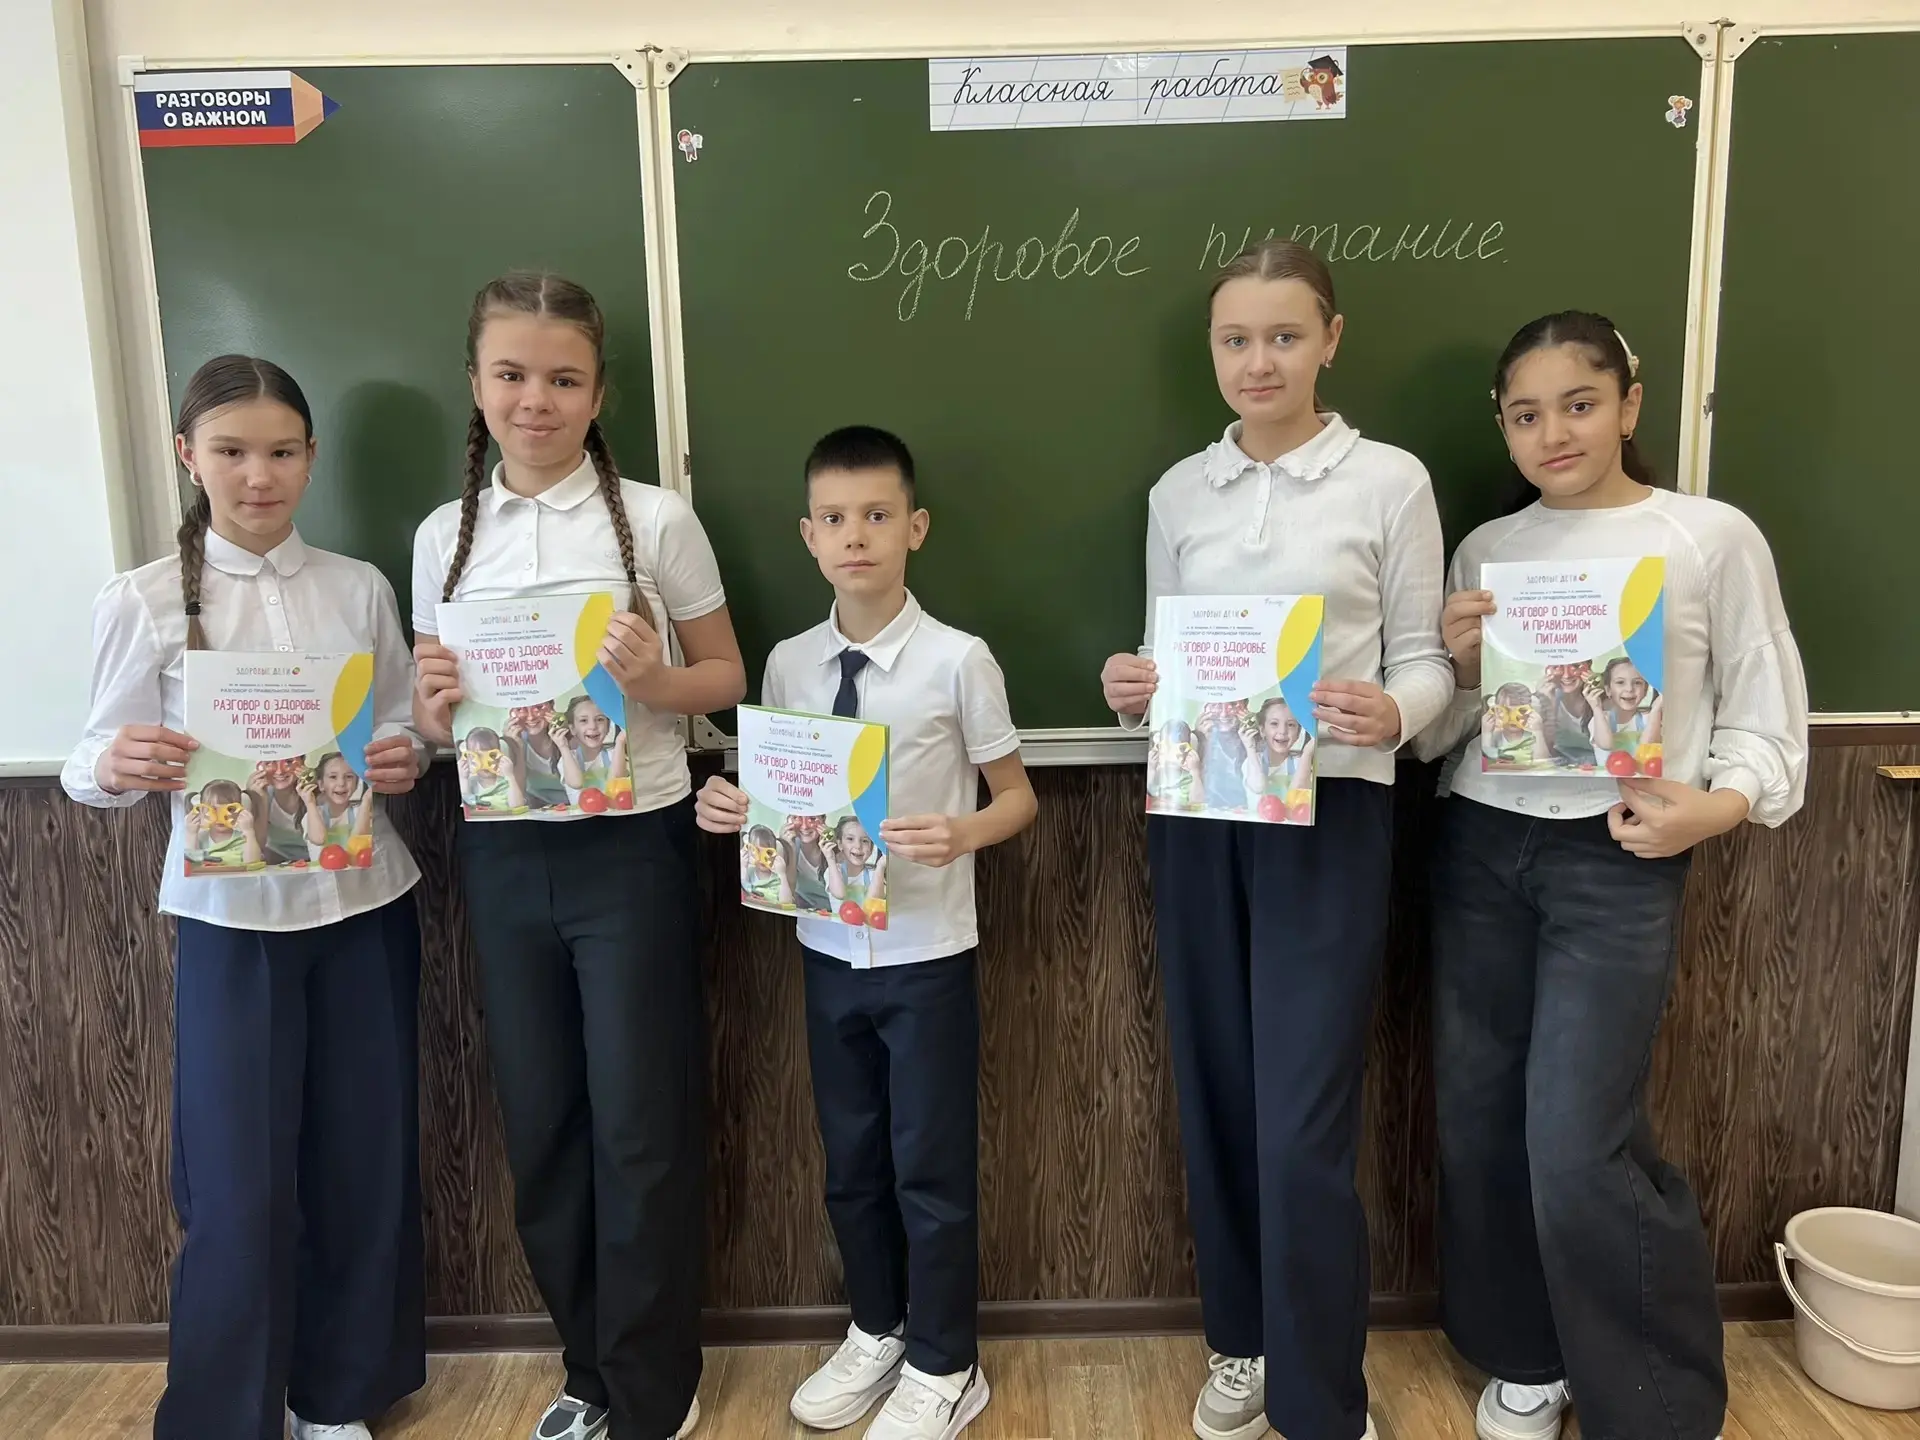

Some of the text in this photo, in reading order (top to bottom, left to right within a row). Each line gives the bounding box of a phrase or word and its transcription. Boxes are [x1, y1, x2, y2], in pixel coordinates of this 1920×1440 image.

[953, 58, 1283, 115] Классная работа
[156, 91, 271, 108] РАЗГОВОРЫ
[163, 110, 267, 127] О ВАЖНОМ
[847, 190, 1151, 322] Здоровое
[1506, 604, 1608, 618] РАЗГОВОР О ЗДОРОВЬЕ
[1522, 619, 1591, 631] И ПРАВИЛЬНОМ
[1535, 632, 1577, 645] ПИТАНИИ
[465, 643, 564, 661] РАЗГОВОР О ЗДОРОВЬЕ
[1214, 642, 1220, 653] О
[1223, 641, 1267, 654] ЗДОРОВЬЕ
[482, 660, 549, 674] И ПРАВИЛЬНОМ
[1187, 656, 1250, 668] И ПРАВИЛЬНОМ
[236, 667, 291, 676] ЗДОРОВЫЕ ДЕТИ
[1197, 669, 1236, 681] ПИТАНИИ
[496, 674, 538, 687] ПИТАНИИ
[213, 699, 321, 711] РАЗГОВОР О ЗДОРОВЬЕ
[232, 713, 305, 725] И ПРАВИЛЬНОМ
[246, 727, 291, 739] ПИТАНИИ
[754, 754, 838, 775] РАЗГОВОР О ЗДОРОВЬЕ
[767, 769, 825, 786] И ПРАВИЛЬНОМ
[778, 783, 813, 798] ПИТАНИИ
